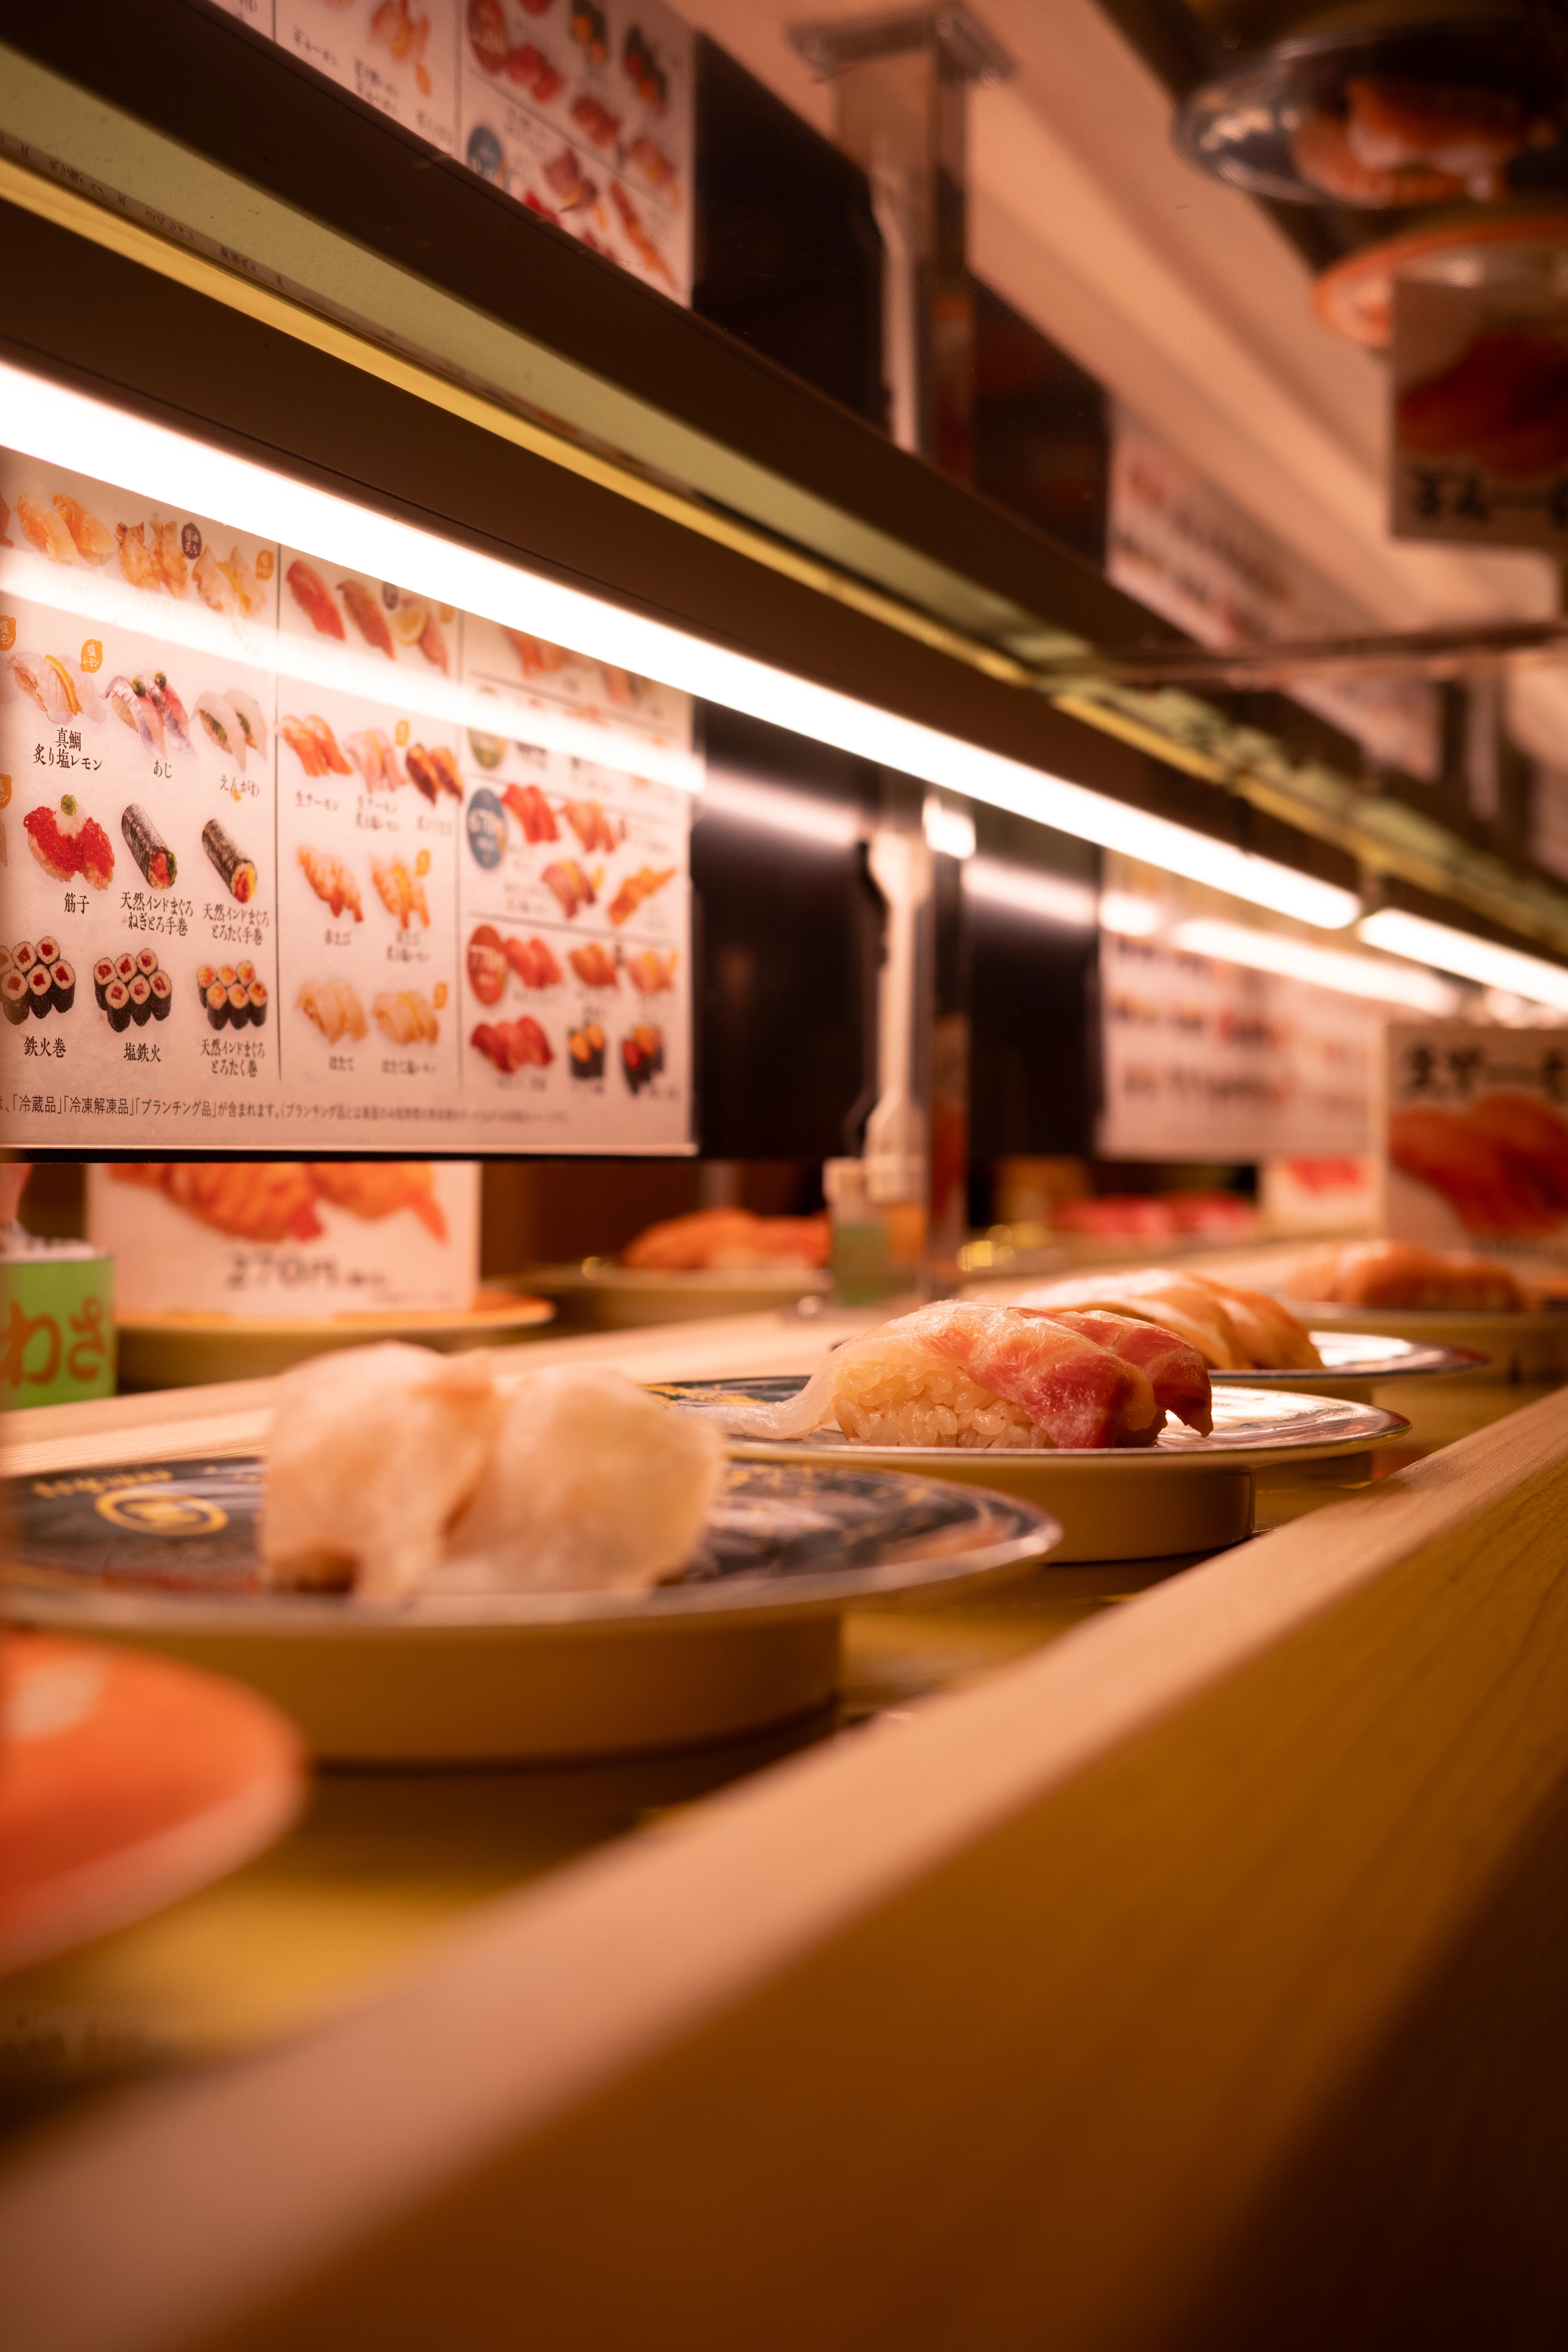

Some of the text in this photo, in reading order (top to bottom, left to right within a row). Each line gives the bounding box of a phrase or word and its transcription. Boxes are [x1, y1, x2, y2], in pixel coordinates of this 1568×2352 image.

[87, 643, 96, 658] 塩
[83, 657, 100, 668] レモン
[55, 727, 82, 752] 真鯛
[32, 743, 103, 771] 炙り塩レモン
[154, 759, 173, 778] あじ
[220, 774, 260, 797] えんがわ
[64, 892, 90, 915] 筋子
[120, 891, 193, 917] 天然インドまぐろ
[128, 911, 188, 936] ねぎとろ手巻
[203, 903, 270, 928] 天然インドまぐろ
[212, 924, 263, 946] とろたく手巻
[23, 1036, 67, 1058] 鉄火巻
[123, 1042, 162, 1063] 塩鉄火
[200, 1038, 265, 1058] 天然インドまぐろ
[212, 1058, 258, 1078] とろたく巻
